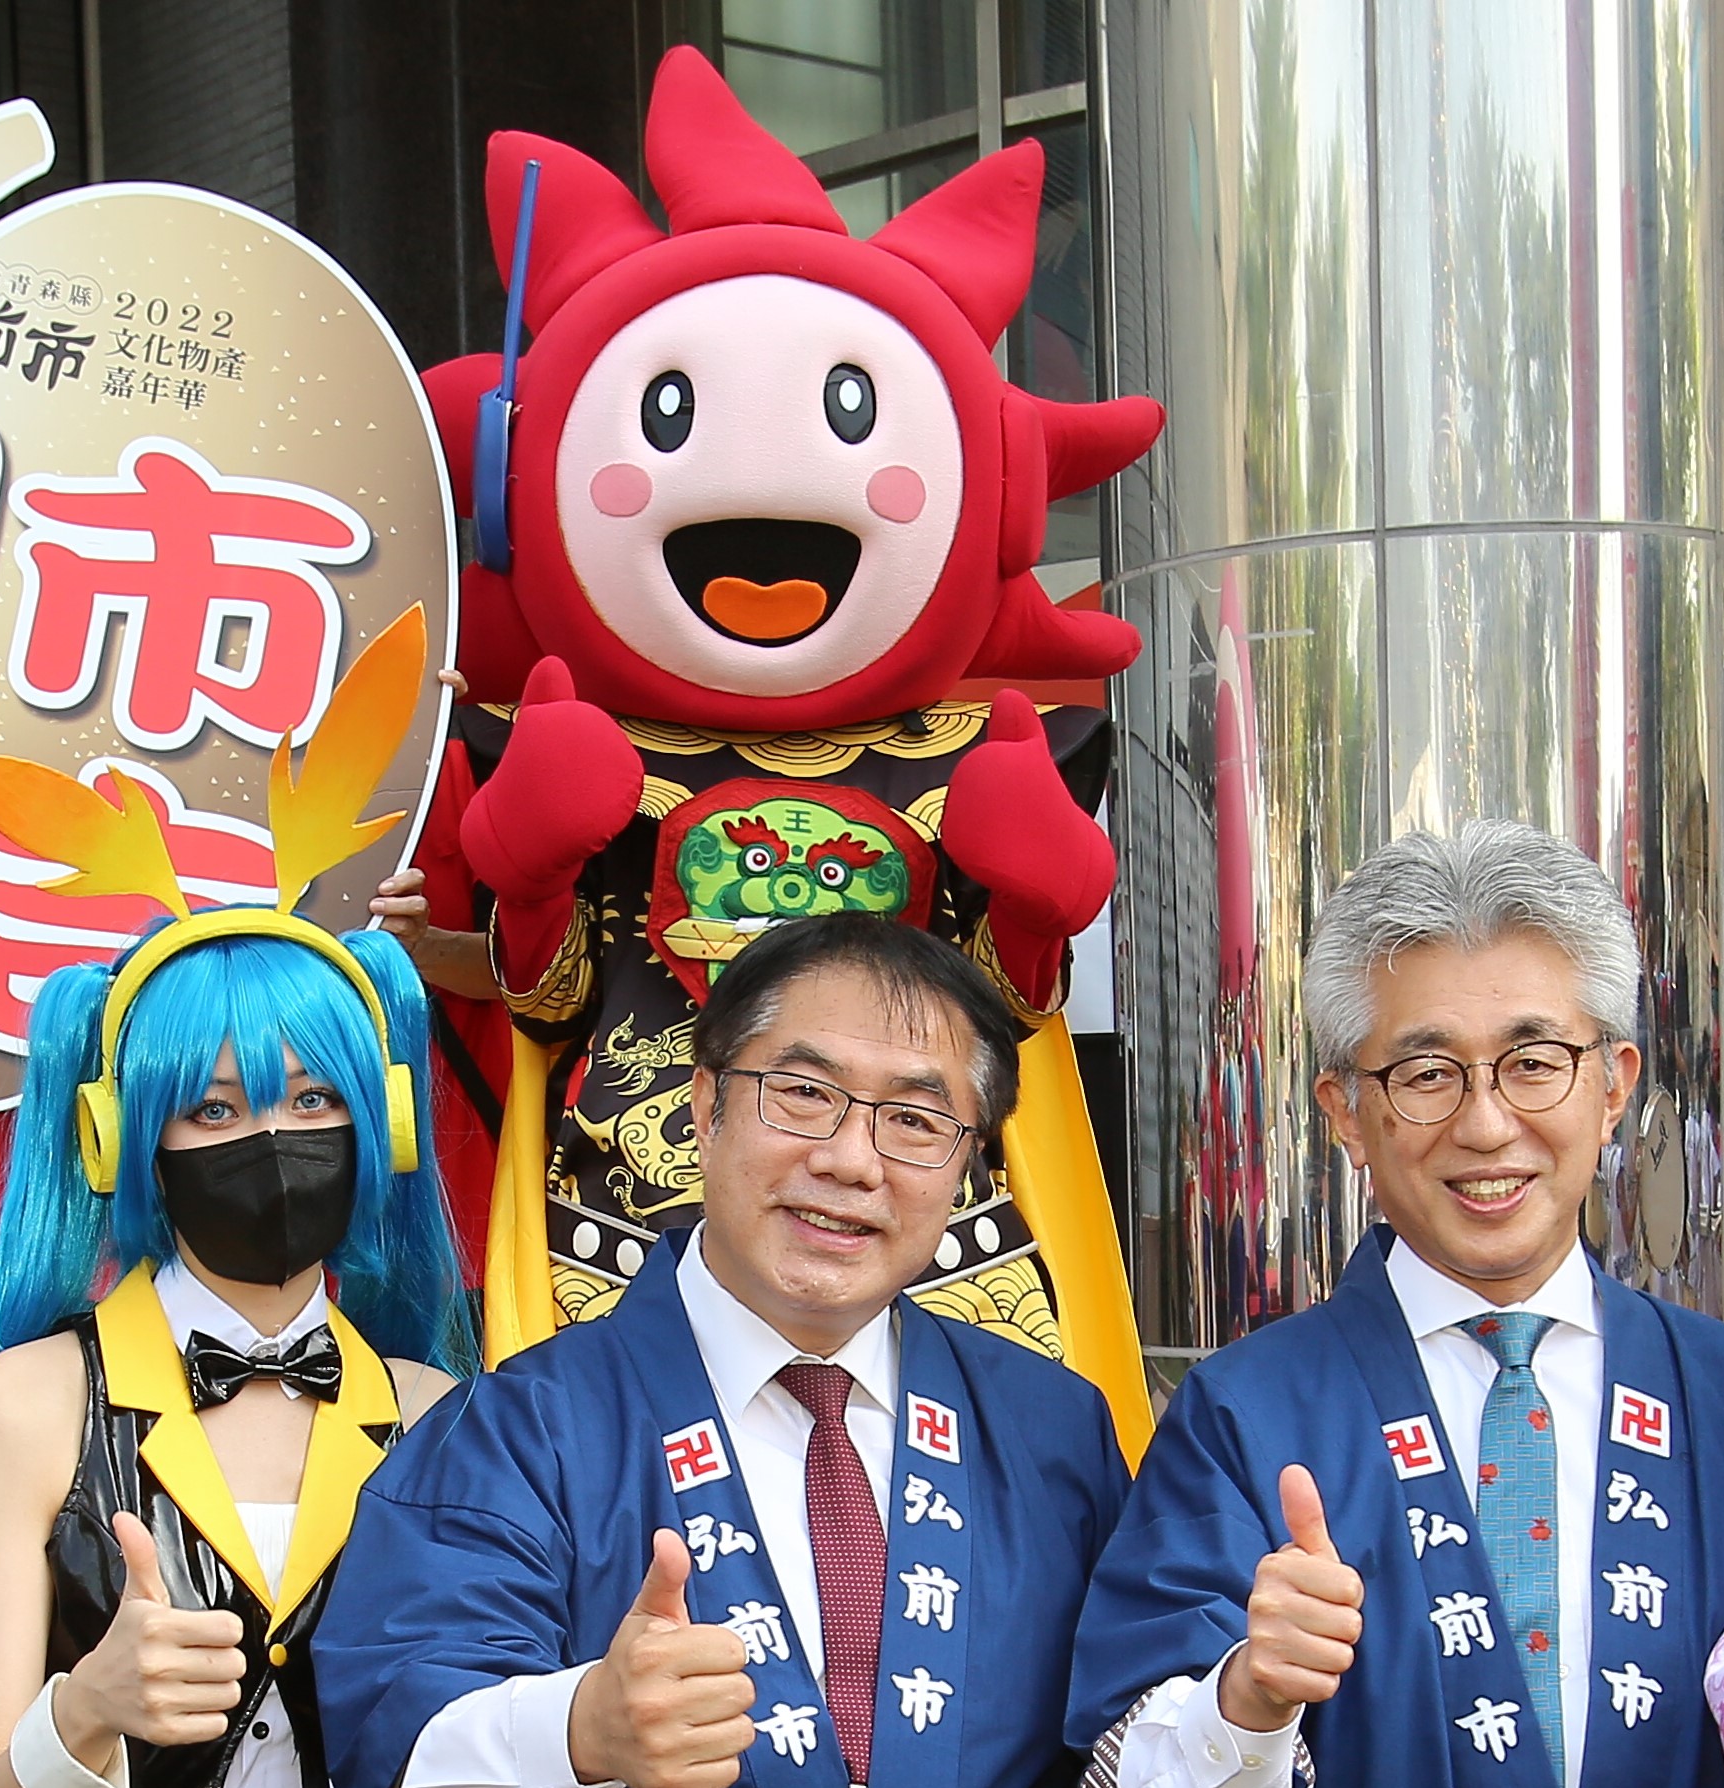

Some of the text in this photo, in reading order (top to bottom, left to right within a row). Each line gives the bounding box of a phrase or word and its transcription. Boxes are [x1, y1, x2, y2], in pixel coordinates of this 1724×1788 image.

[100, 366, 208, 410] 嘉年華
[105, 329, 249, 381] 文化物產
[114, 292, 235, 339] 2022
[783, 809, 812, 834] 王
[682, 1513, 821, 1768] 弘前市
[891, 1472, 965, 1735] 弘前市
[1404, 1506, 1523, 1763] 弘前市
[1600, 1469, 1671, 1730] 弘前市
